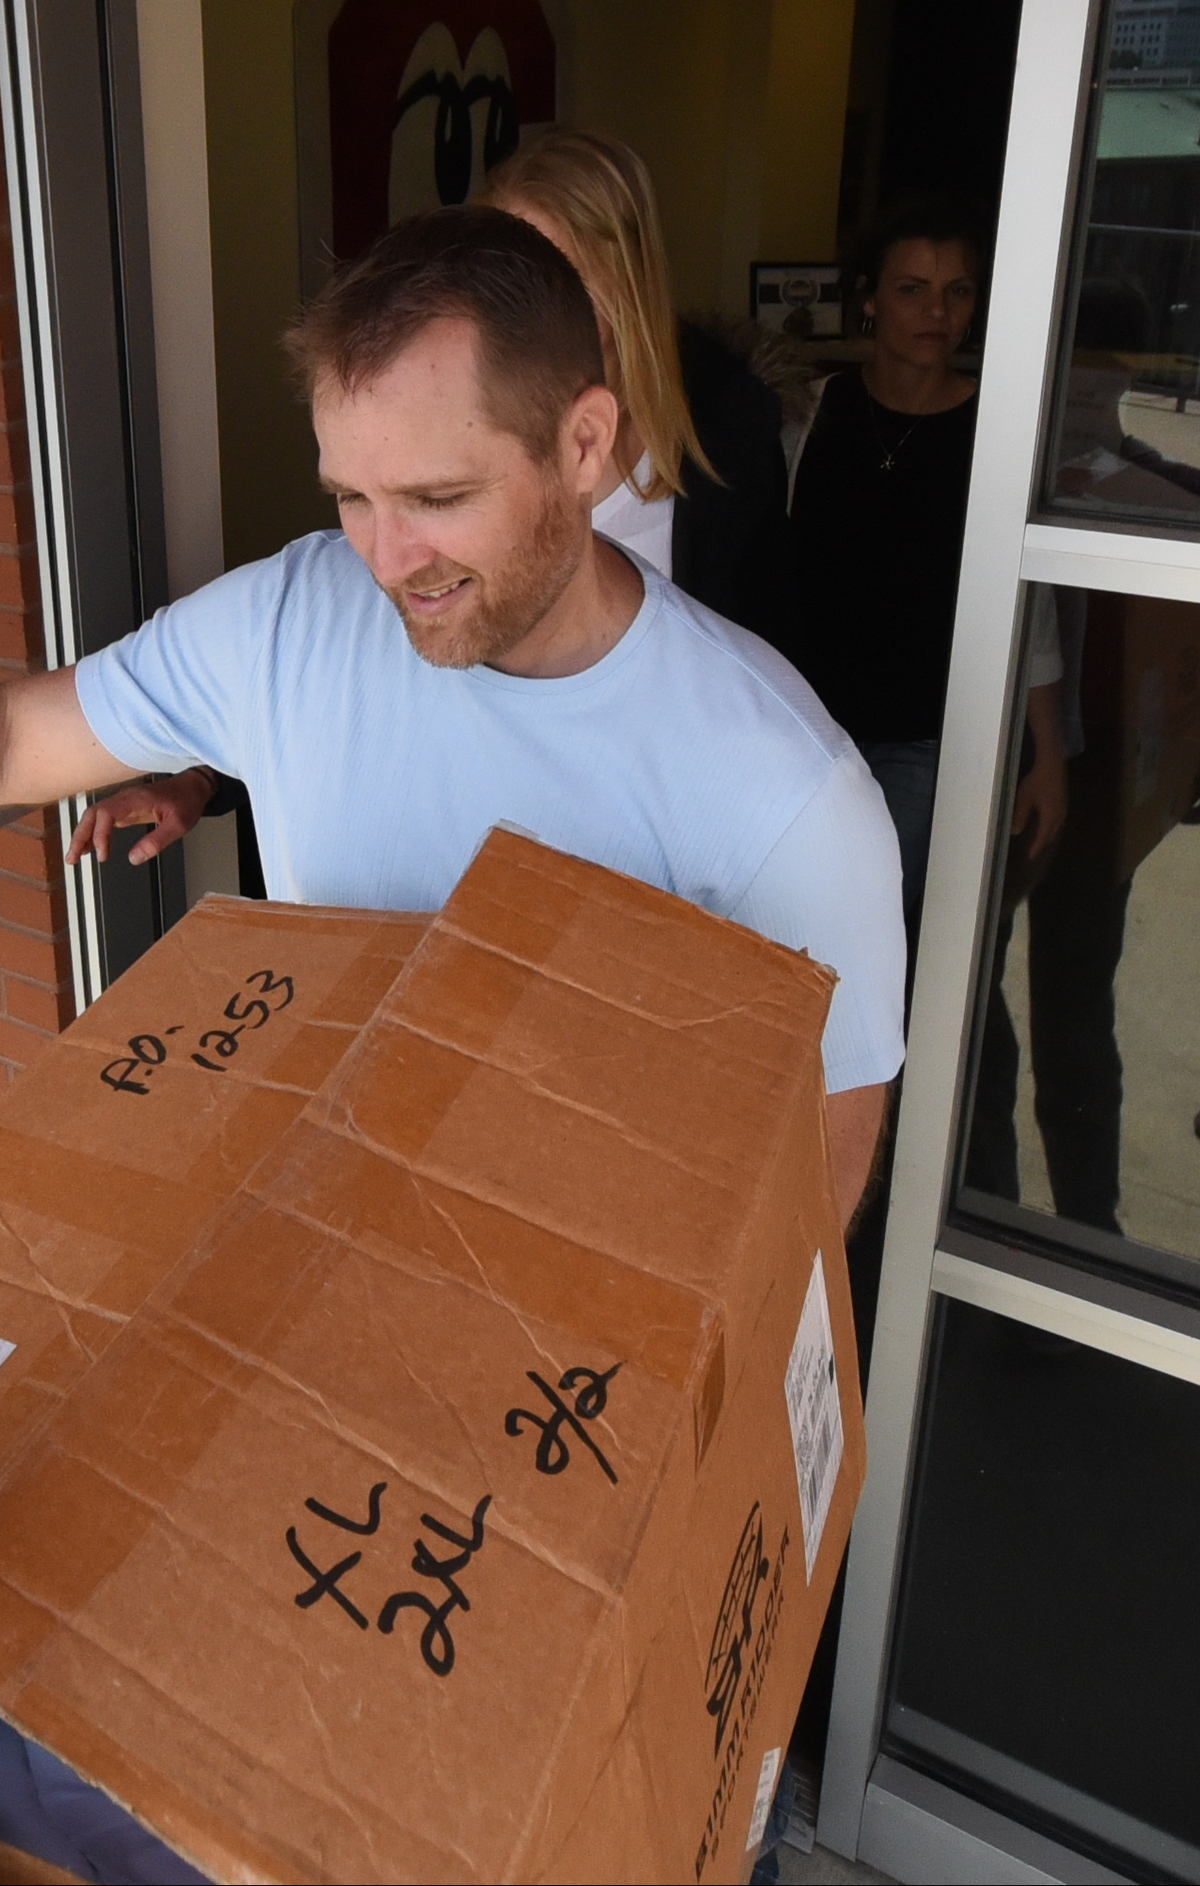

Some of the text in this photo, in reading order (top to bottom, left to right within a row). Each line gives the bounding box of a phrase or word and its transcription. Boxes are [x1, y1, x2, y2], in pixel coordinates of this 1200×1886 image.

[190, 970, 294, 1072] 1253
[504, 1359, 628, 1486] 2/2
[285, 1481, 388, 1631] XL
[376, 1493, 493, 1677] 2XL
[740, 1522, 790, 1722] RIDDER
